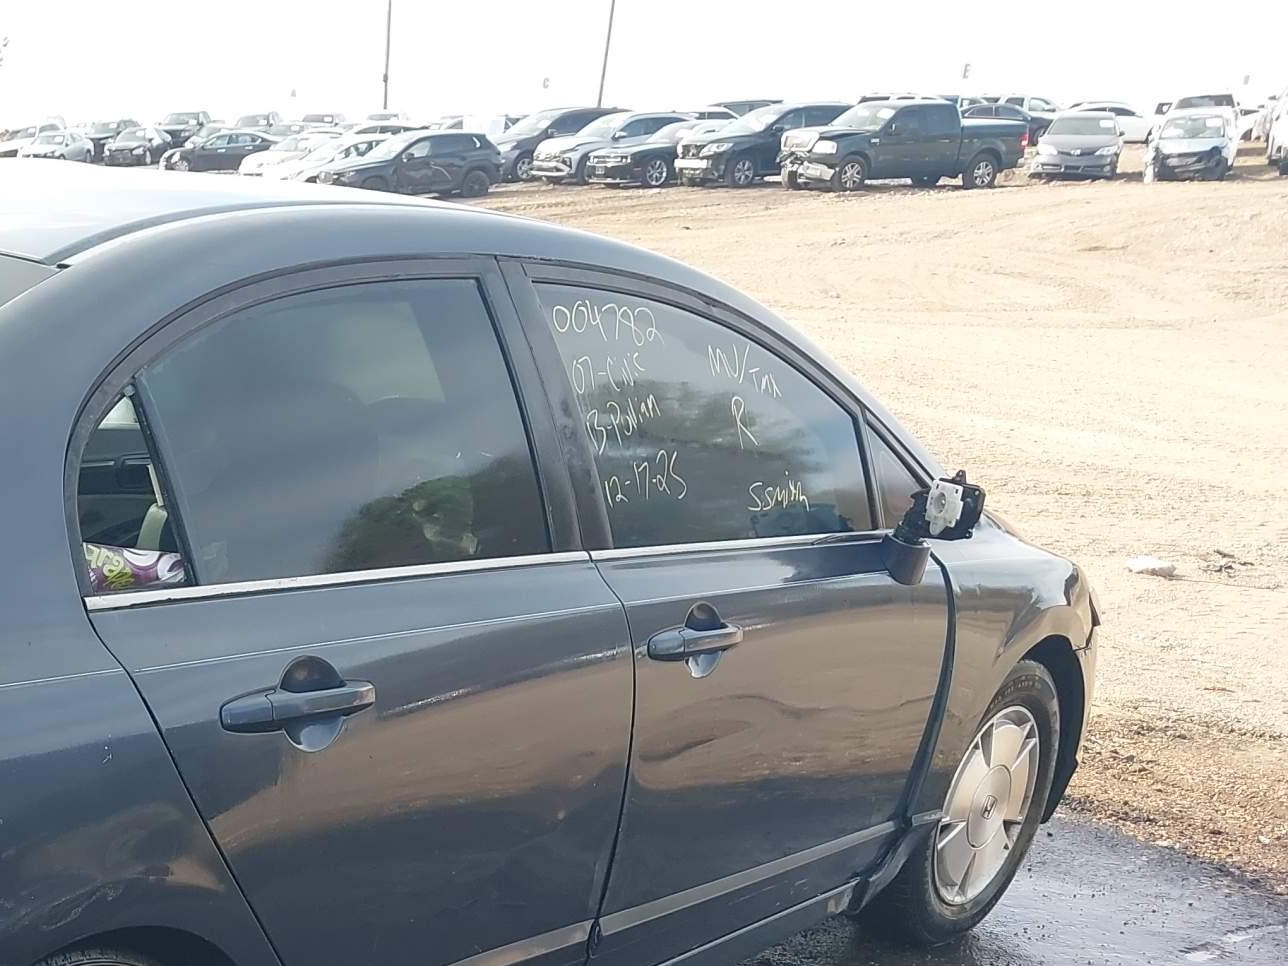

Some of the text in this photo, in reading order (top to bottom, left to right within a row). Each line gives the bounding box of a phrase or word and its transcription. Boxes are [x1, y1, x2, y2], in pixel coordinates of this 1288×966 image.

[552, 299, 665, 347] 004782
[730, 395, 760, 449] R
[604, 449, 687, 509] 12-17-25
